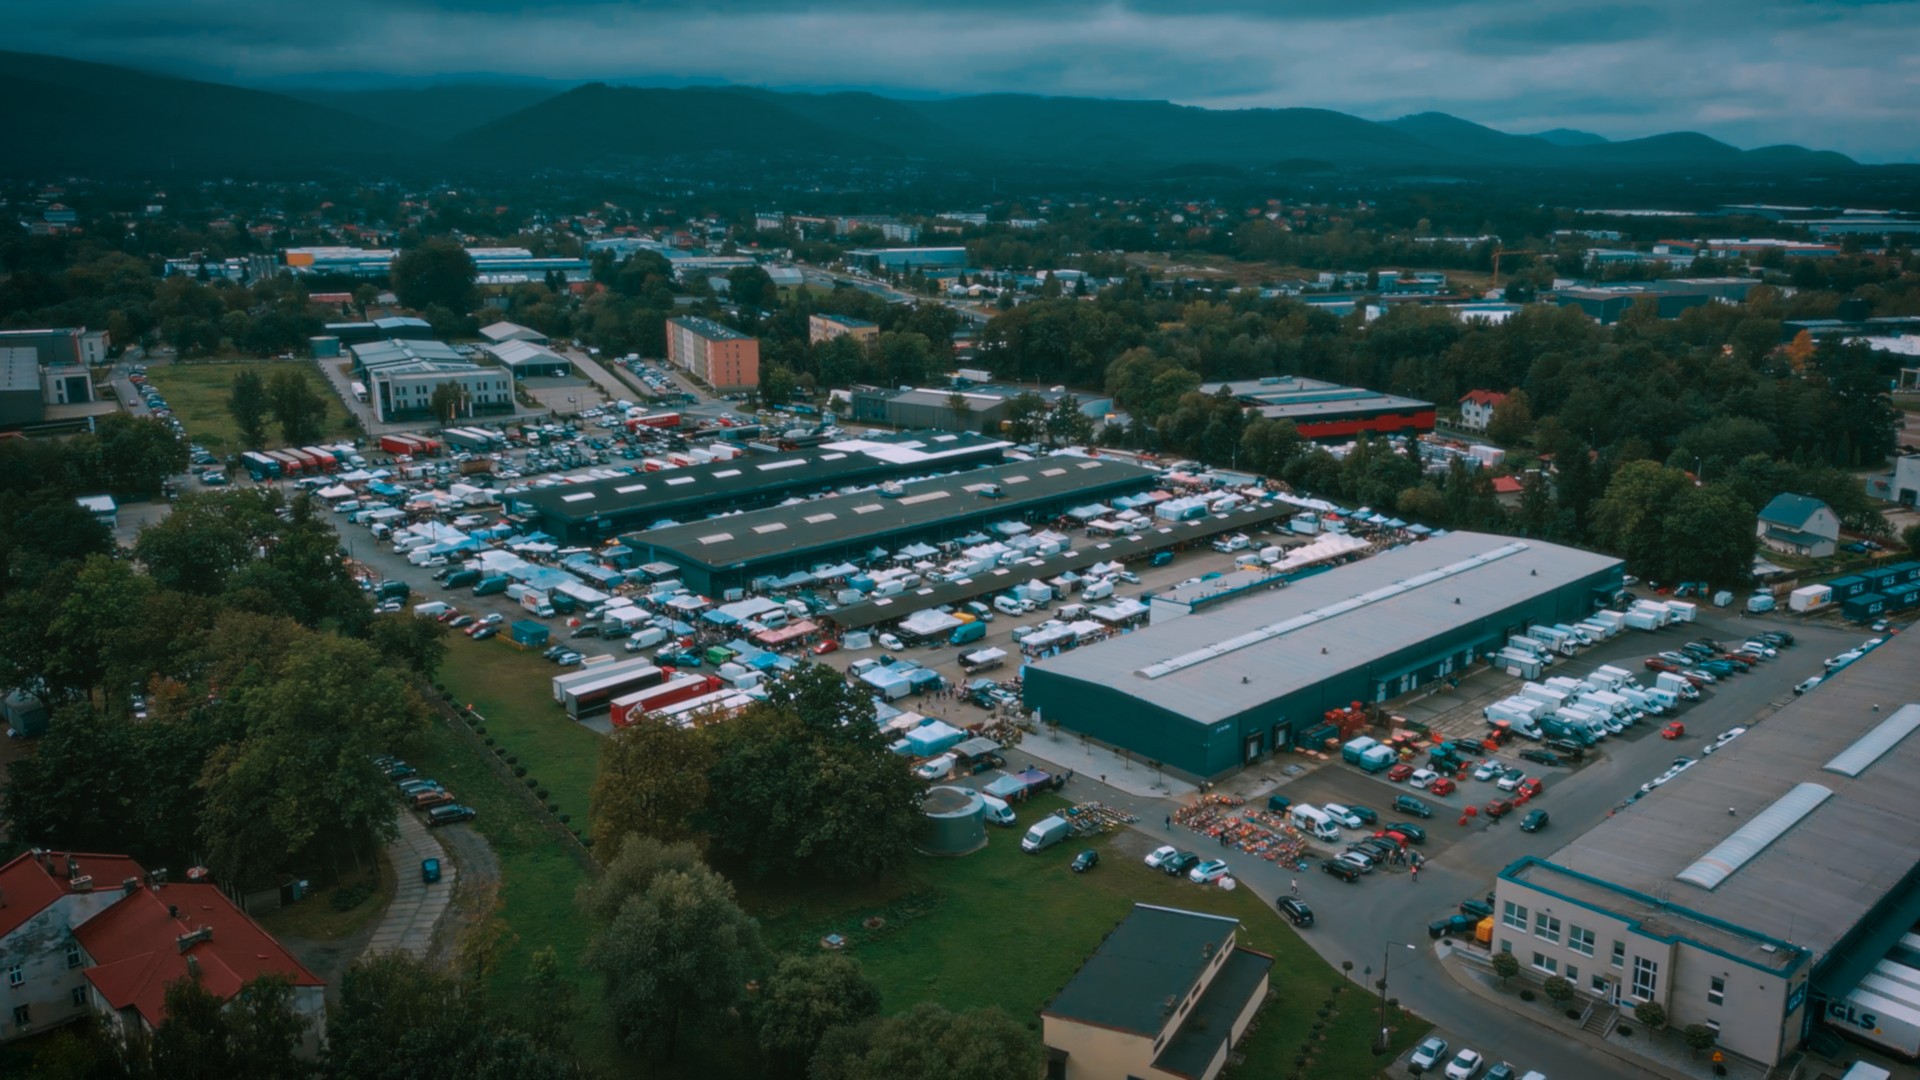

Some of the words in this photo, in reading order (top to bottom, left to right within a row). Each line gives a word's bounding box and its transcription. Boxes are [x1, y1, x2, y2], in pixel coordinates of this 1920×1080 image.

[1882, 575, 1895, 587] GLS
[1850, 583, 1864, 595] GLS
[1904, 591, 1918, 603] GLS
[1869, 602, 1882, 613] GLS
[1829, 1002, 1877, 1031] GLS
